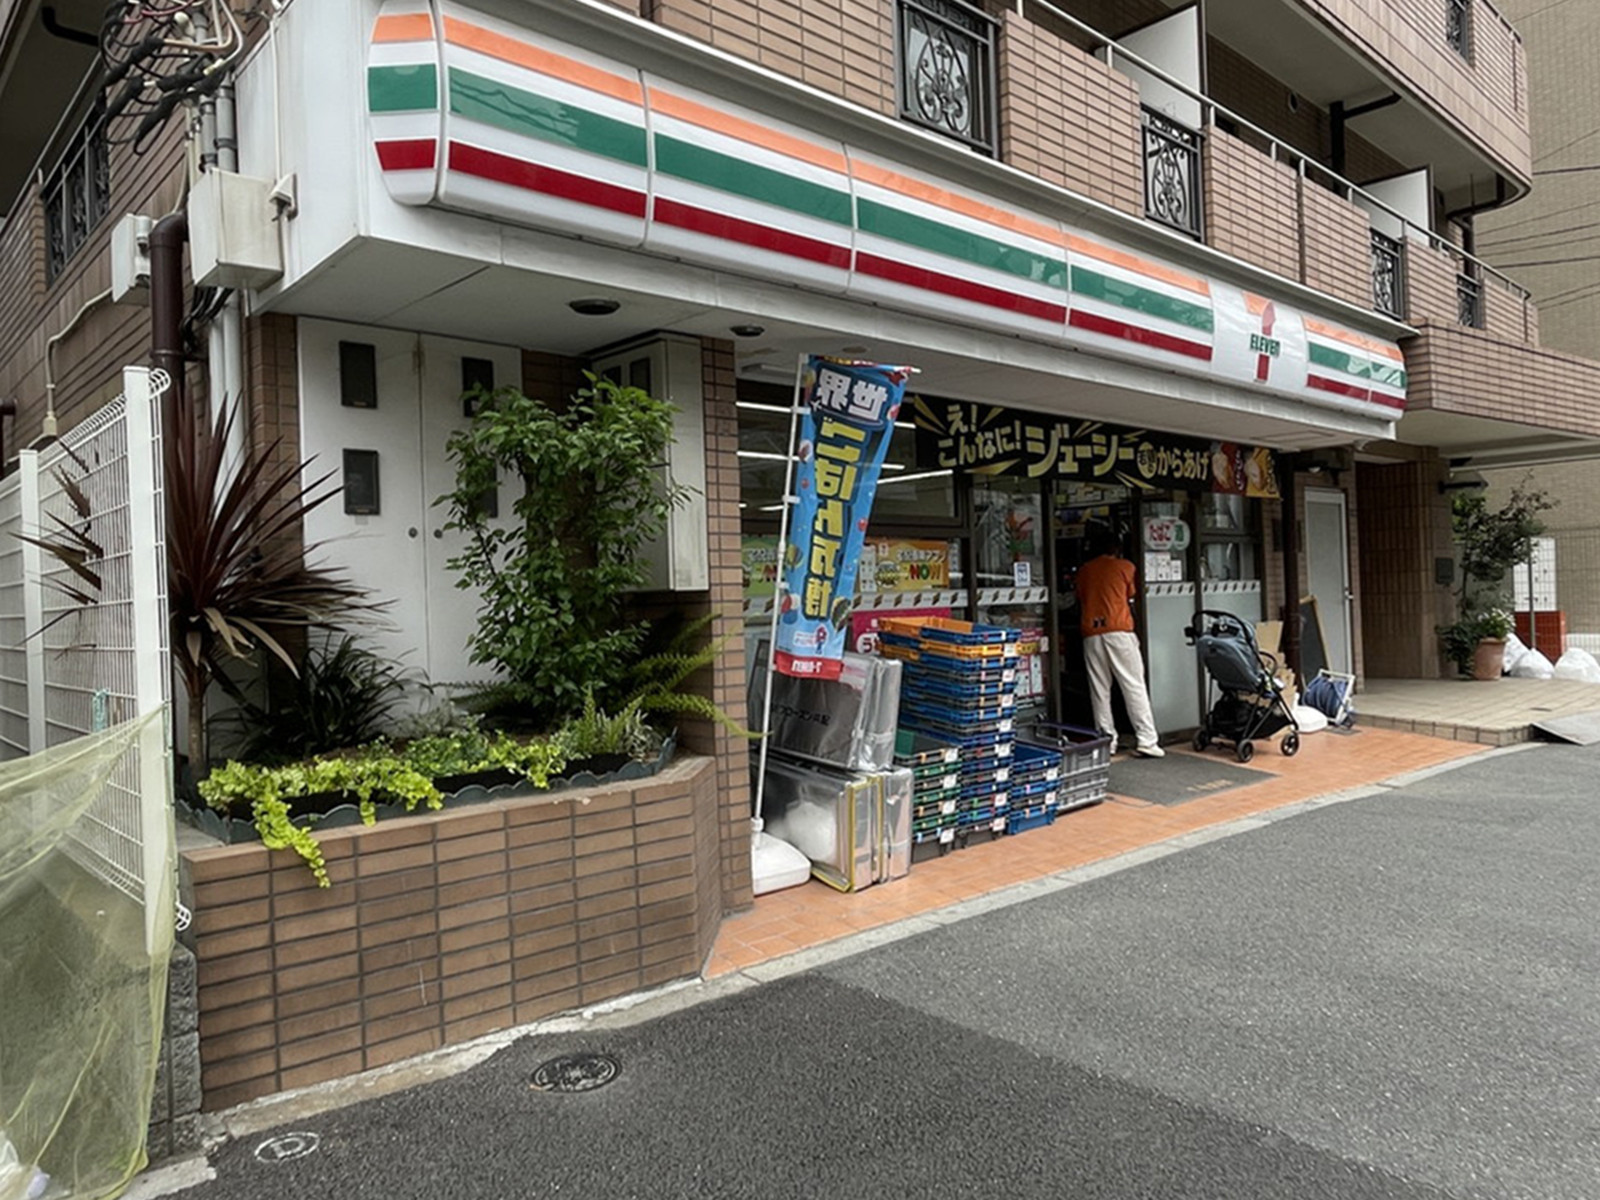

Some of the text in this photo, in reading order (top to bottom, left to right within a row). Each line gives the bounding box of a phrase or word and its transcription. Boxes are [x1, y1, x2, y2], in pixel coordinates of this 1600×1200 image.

[1025, 423, 1135, 478] ジューシー
[1157, 446, 1210, 481] からあげ
